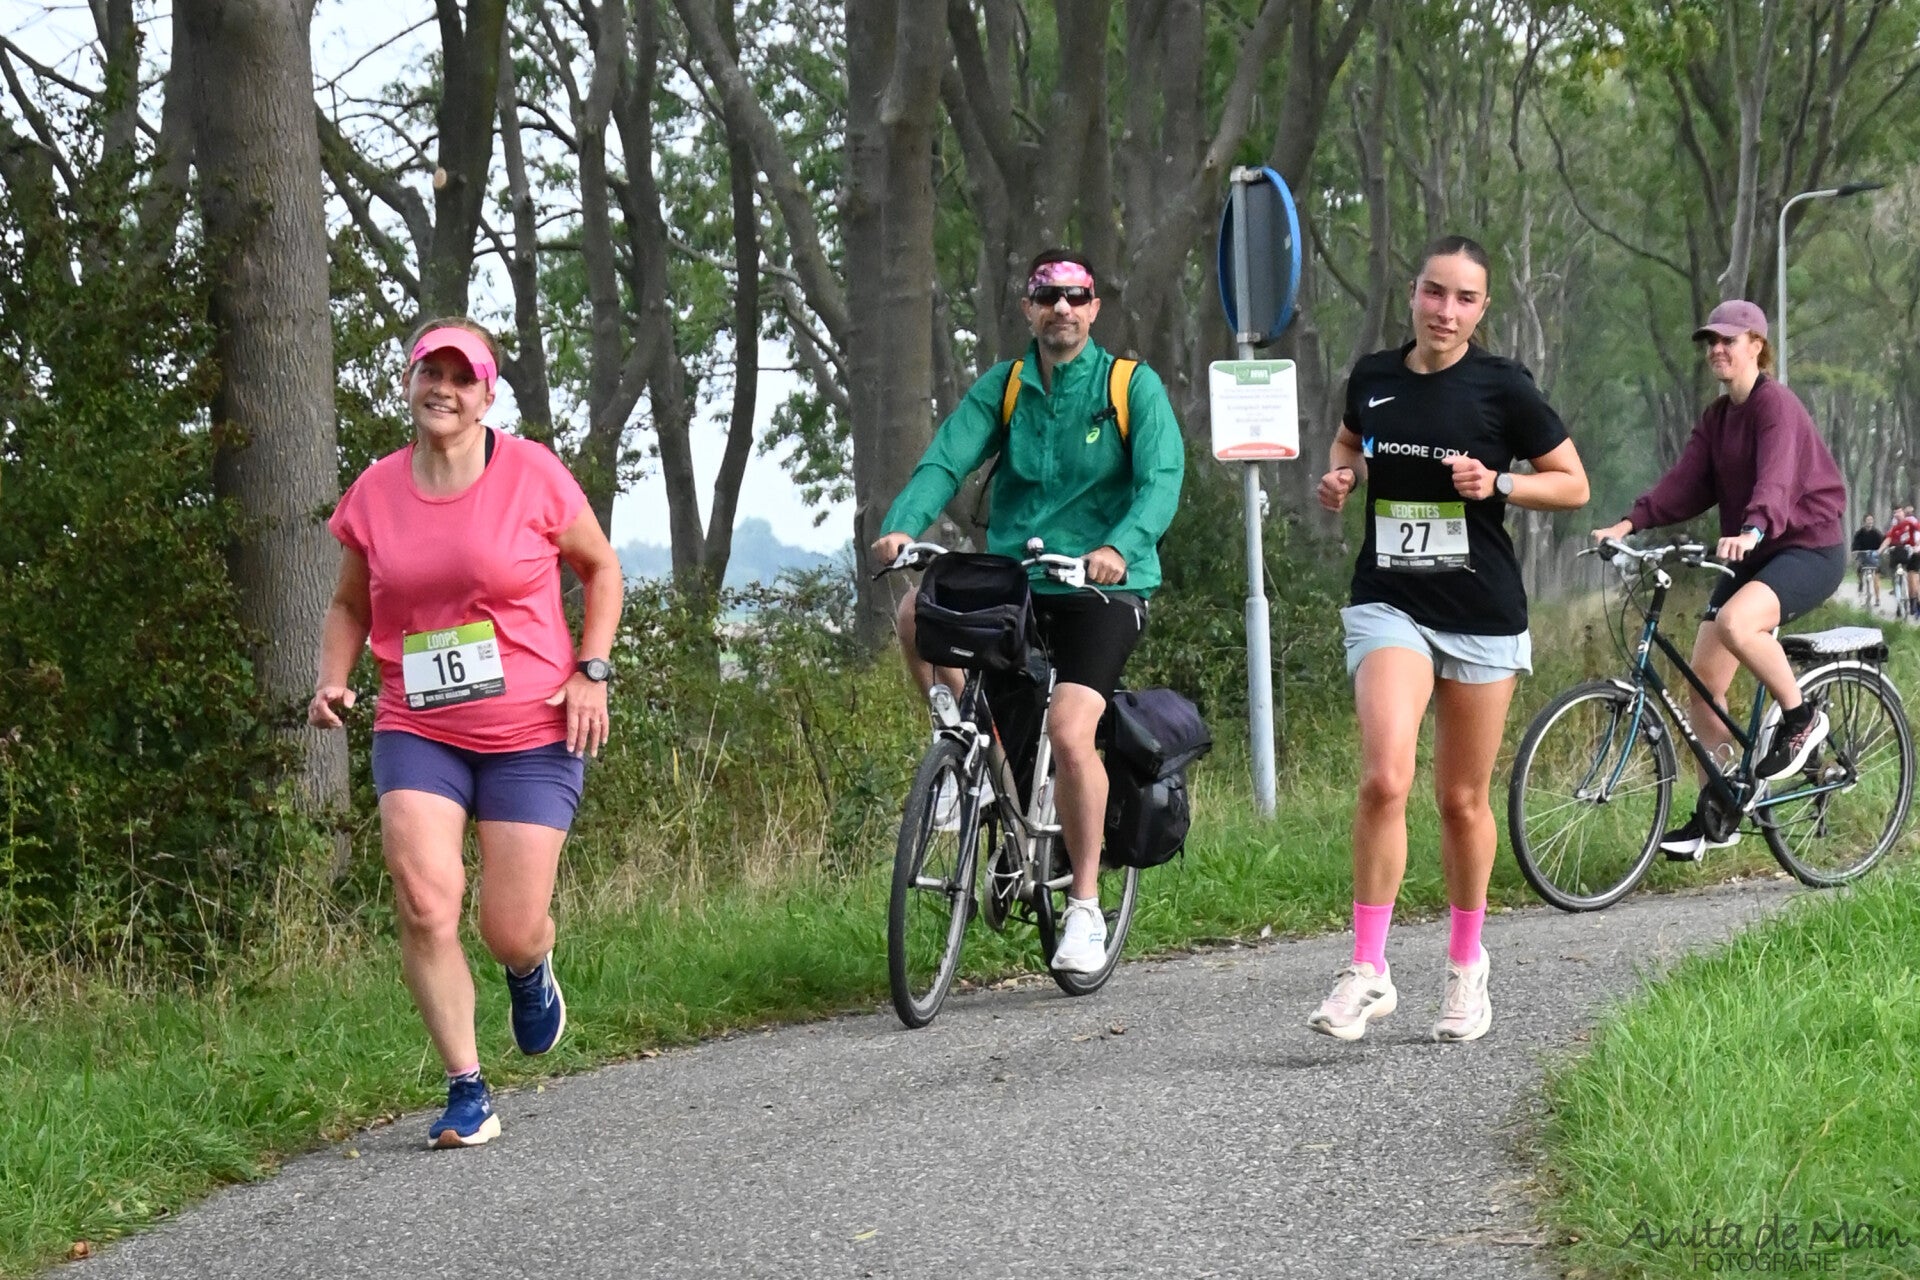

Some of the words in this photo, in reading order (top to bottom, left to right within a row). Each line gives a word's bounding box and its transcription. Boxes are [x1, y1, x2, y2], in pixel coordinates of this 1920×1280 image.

[1378, 442, 1429, 457] MOORE
[1391, 504, 1440, 518] VEDETTES
[1400, 522, 1431, 553] 27
[427, 631, 459, 648] LOOPS
[432, 650, 466, 686] 16
